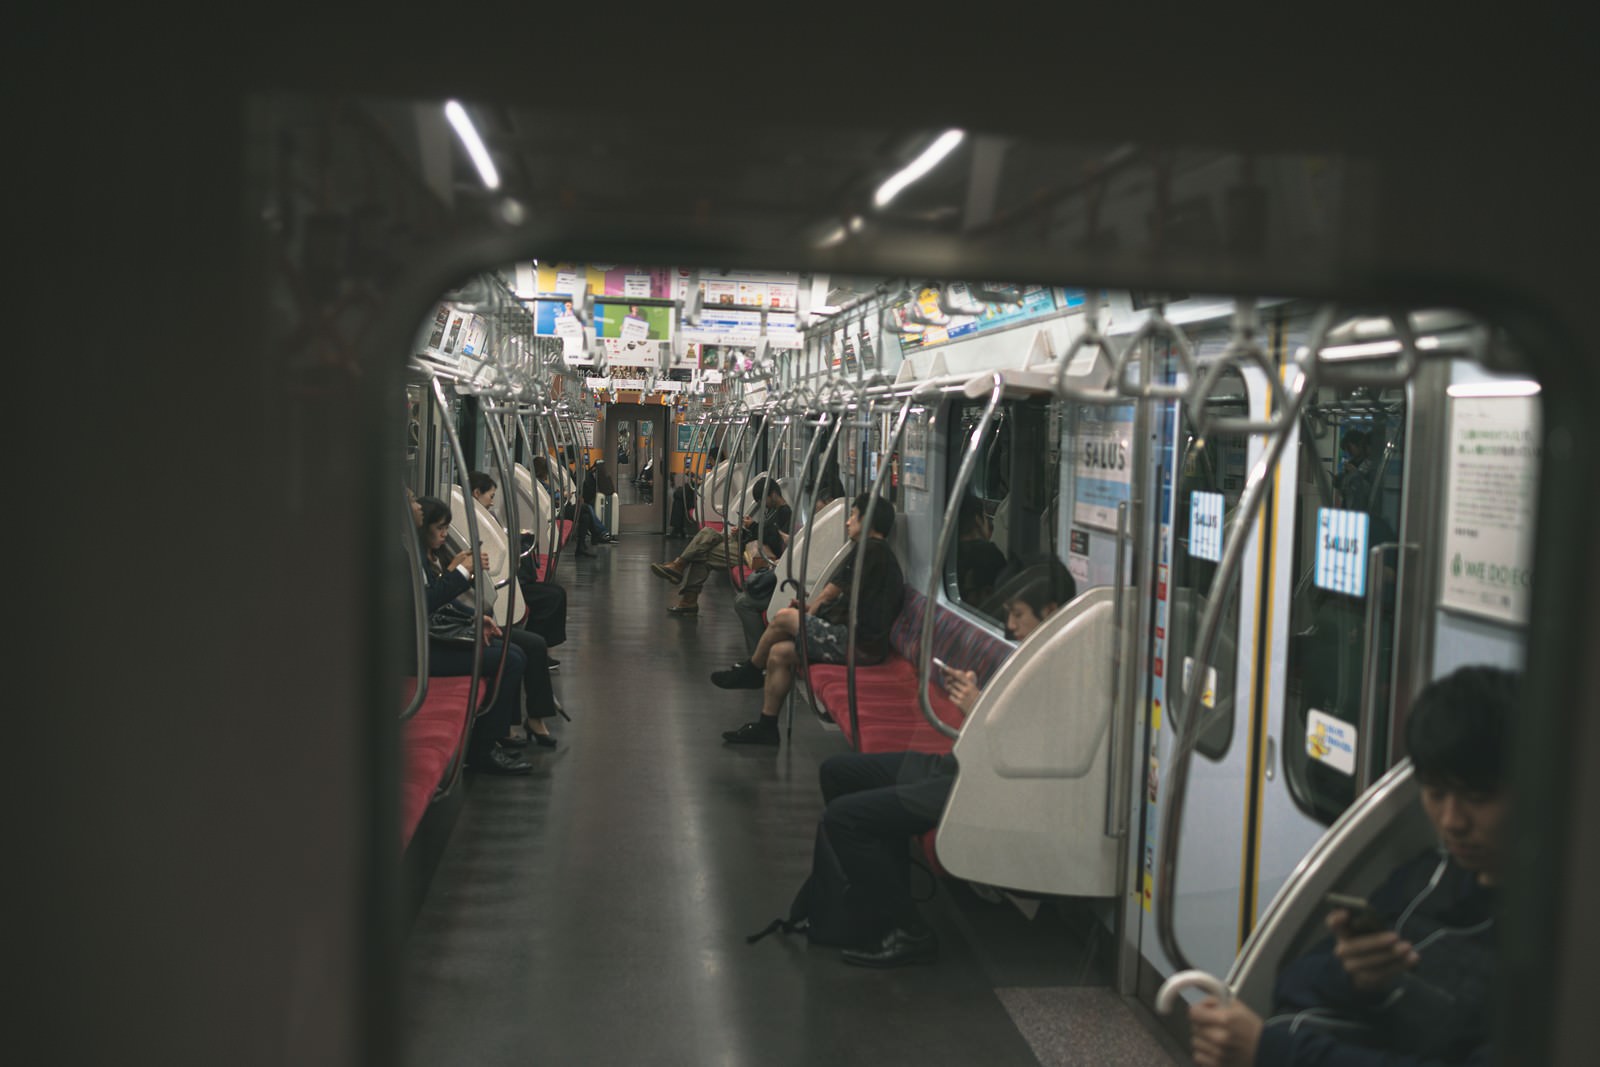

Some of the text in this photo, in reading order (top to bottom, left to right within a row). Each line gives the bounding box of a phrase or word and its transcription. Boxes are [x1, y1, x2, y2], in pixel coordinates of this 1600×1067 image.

[1085, 442, 1126, 471] SALUS
[1195, 511, 1218, 529] SALUS
[1324, 533, 1359, 555] SALUS
